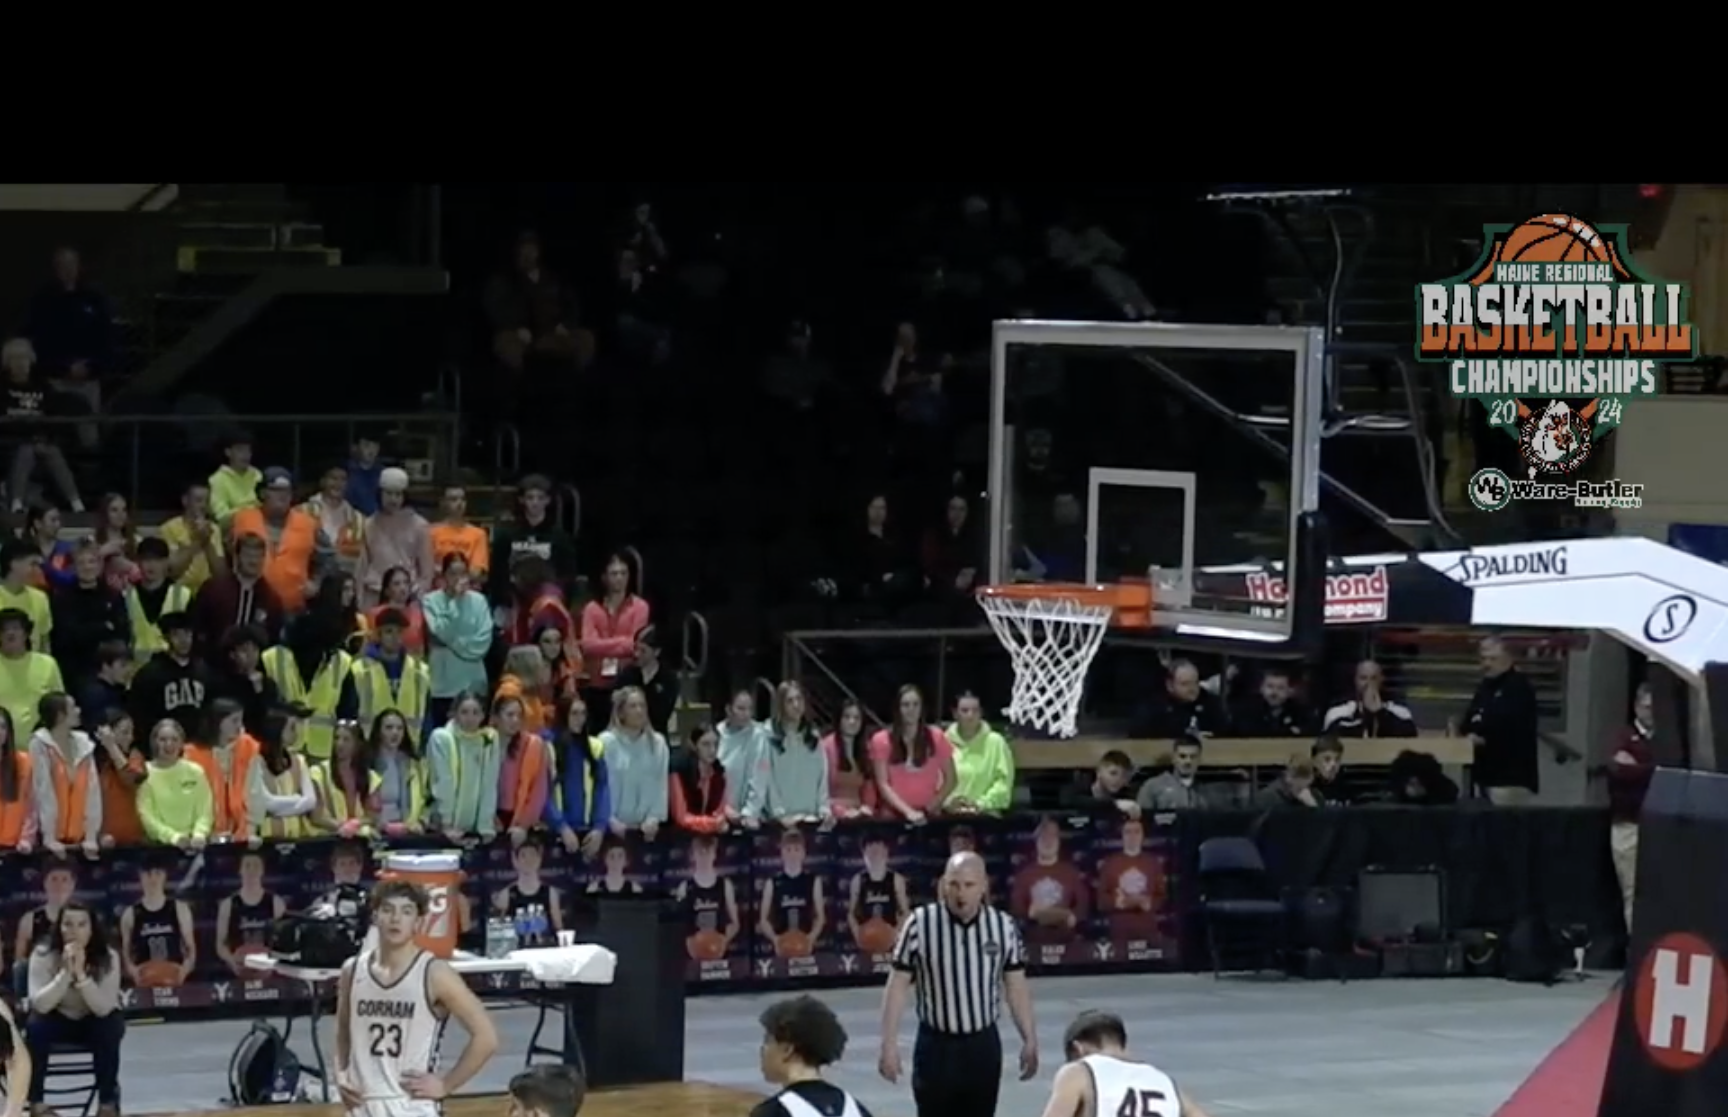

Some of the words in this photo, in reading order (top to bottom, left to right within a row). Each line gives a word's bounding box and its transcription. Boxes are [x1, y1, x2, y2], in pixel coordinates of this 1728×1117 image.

[1452, 546, 1567, 582] SPALDING
[1324, 601, 1382, 619] ompany
[163, 677, 206, 711] GAP
[357, 999, 416, 1019] GORHAM
[1648, 948, 1713, 1054] H
[369, 1022, 403, 1058] 23
